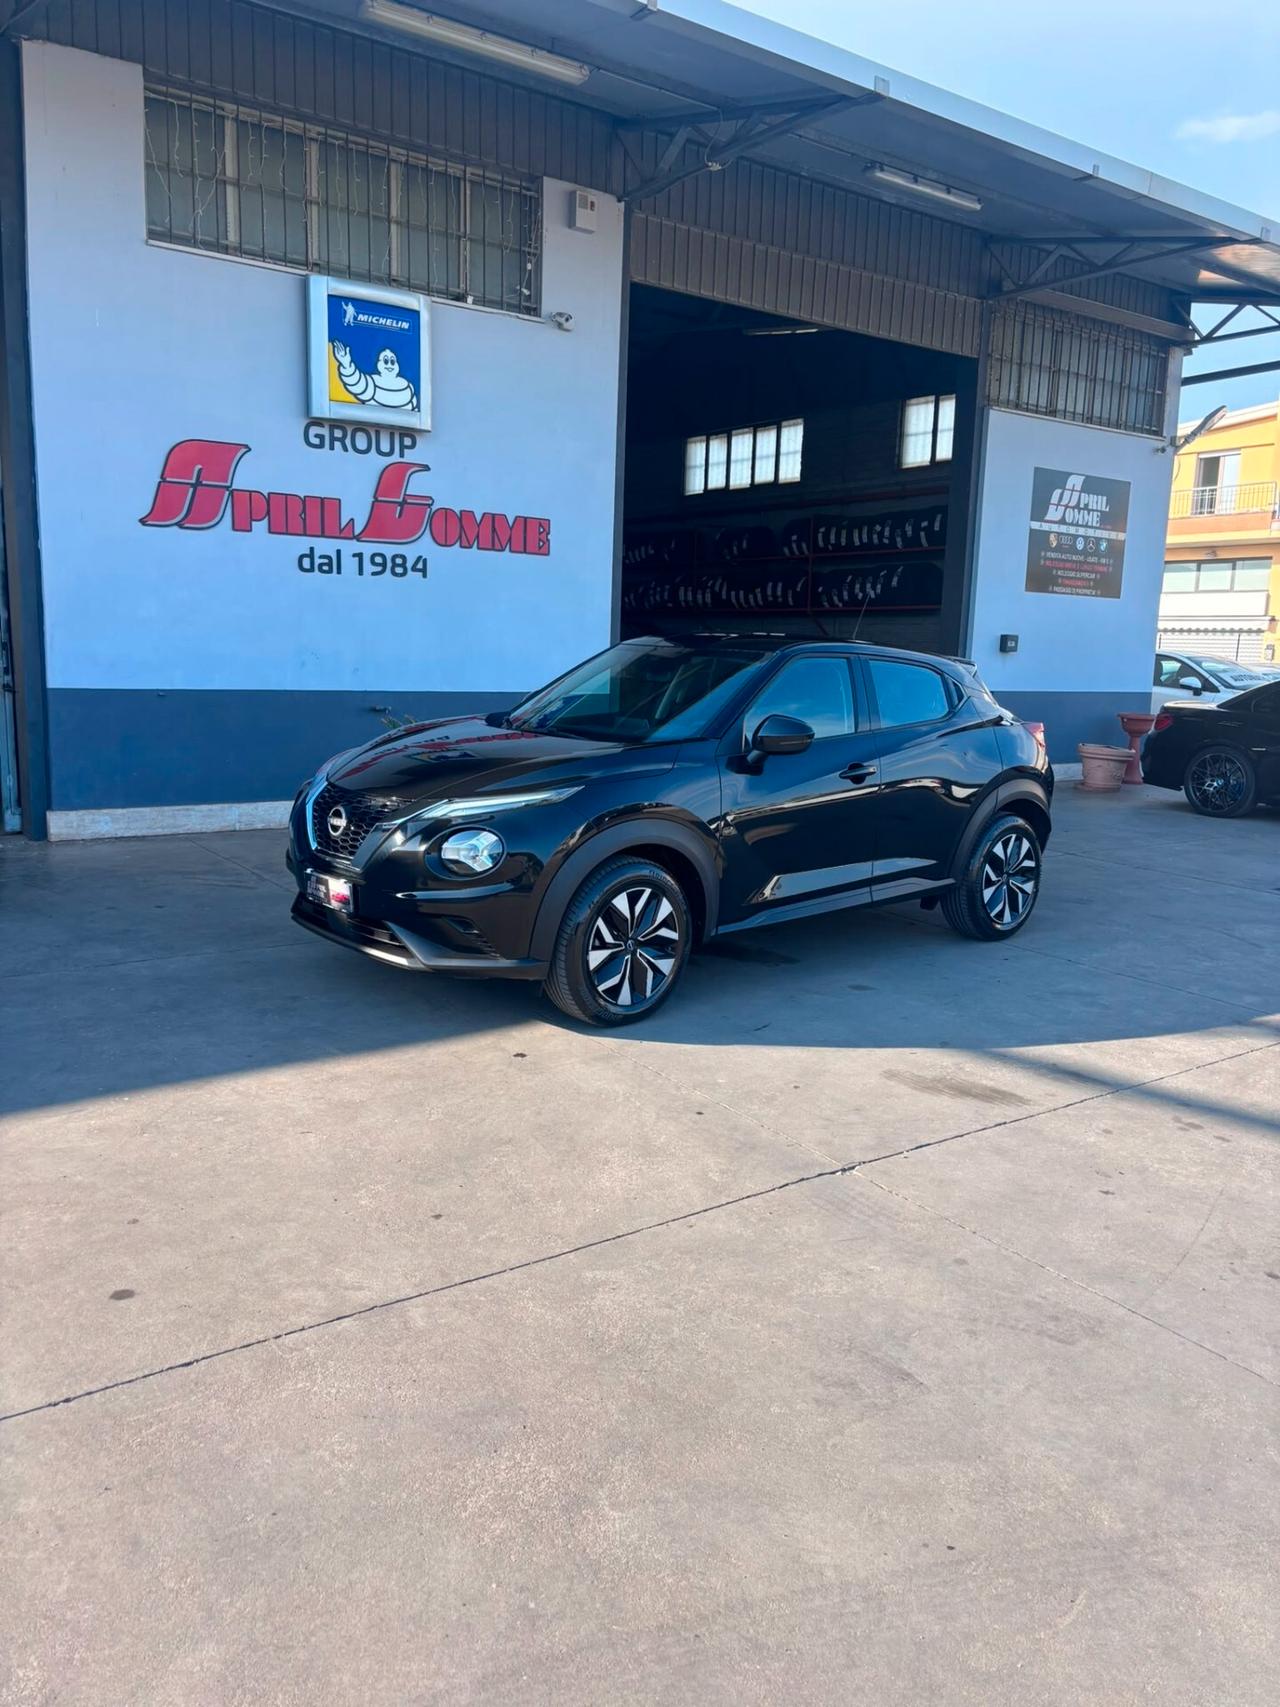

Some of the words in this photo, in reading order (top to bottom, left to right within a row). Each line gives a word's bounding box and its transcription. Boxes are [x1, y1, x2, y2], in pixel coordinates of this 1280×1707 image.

[356, 312, 410, 330] MICHELIN
[303, 420, 418, 459] GROUP
[138, 438, 355, 541] APRIL
[355, 461, 551, 557] GOMME
[298, 546, 342, 576] dal
[352, 552, 429, 580] 1984
